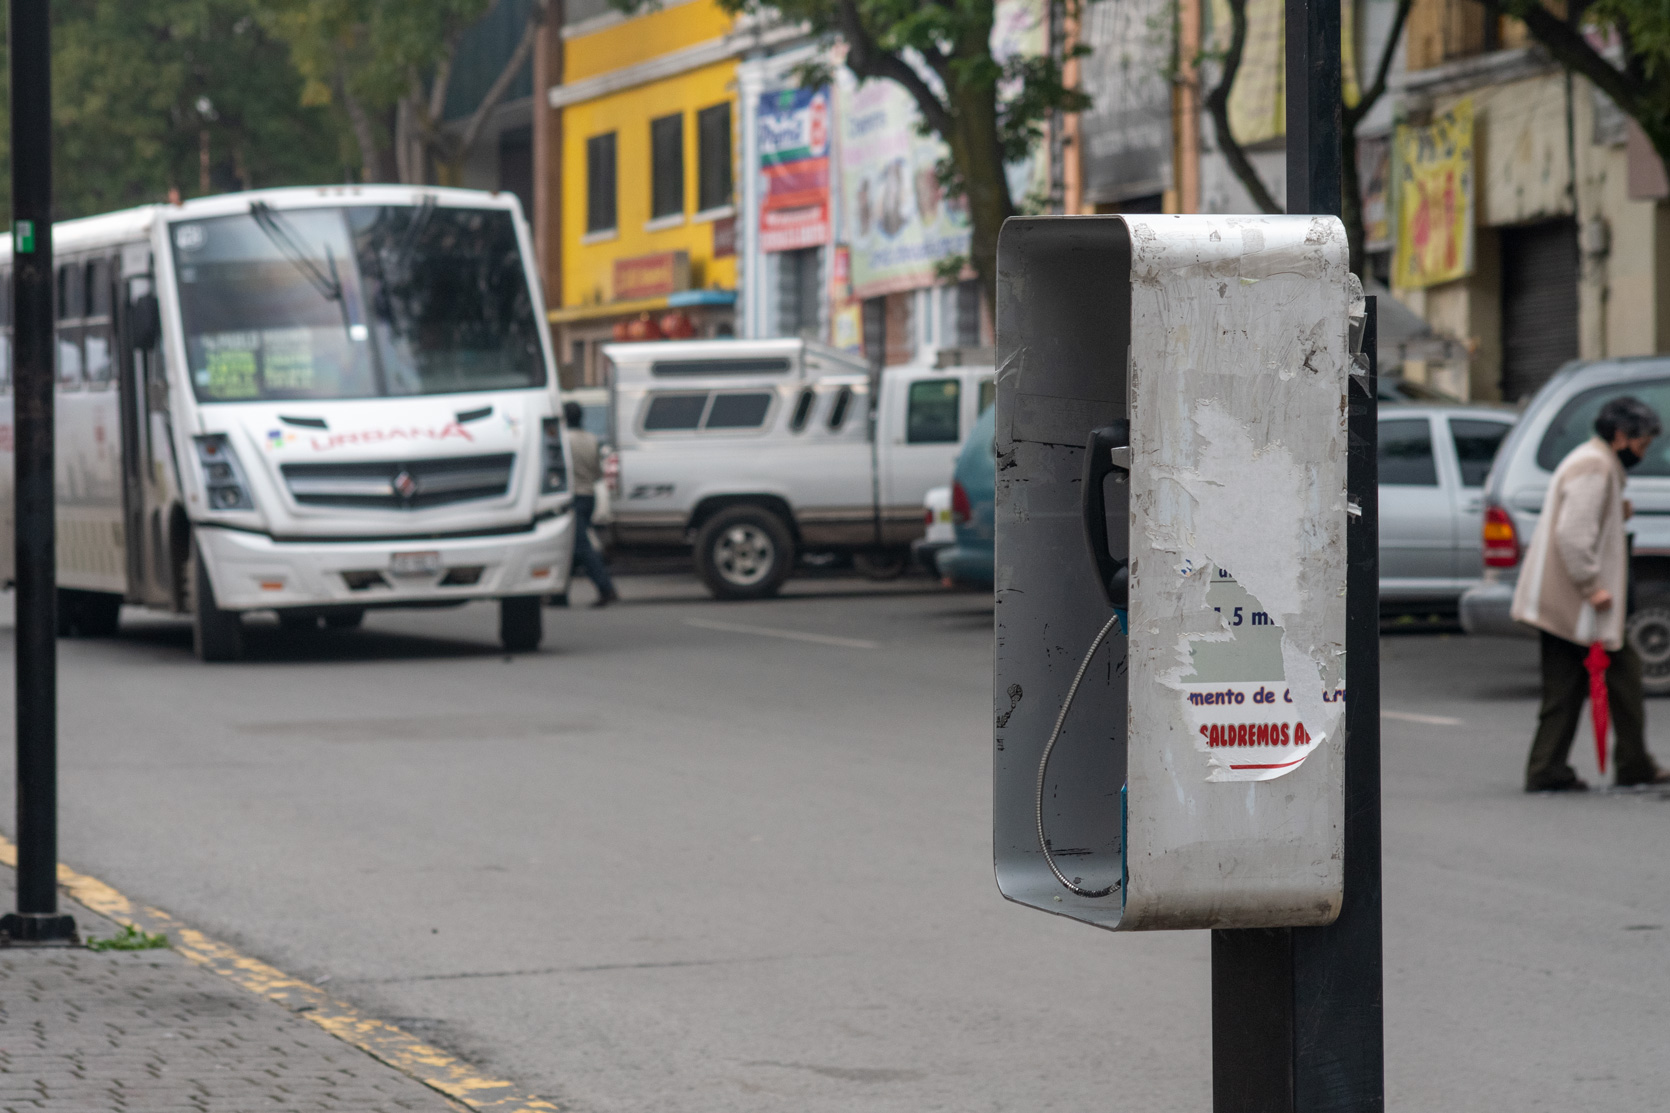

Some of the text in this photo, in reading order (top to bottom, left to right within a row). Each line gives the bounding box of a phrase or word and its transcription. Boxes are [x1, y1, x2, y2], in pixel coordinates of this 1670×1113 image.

[310, 421, 475, 451] URBANA
[1187, 688, 1245, 706] mento
[1253, 686, 1276, 704] de
[1199, 722, 1290, 748] SALDREMOS
